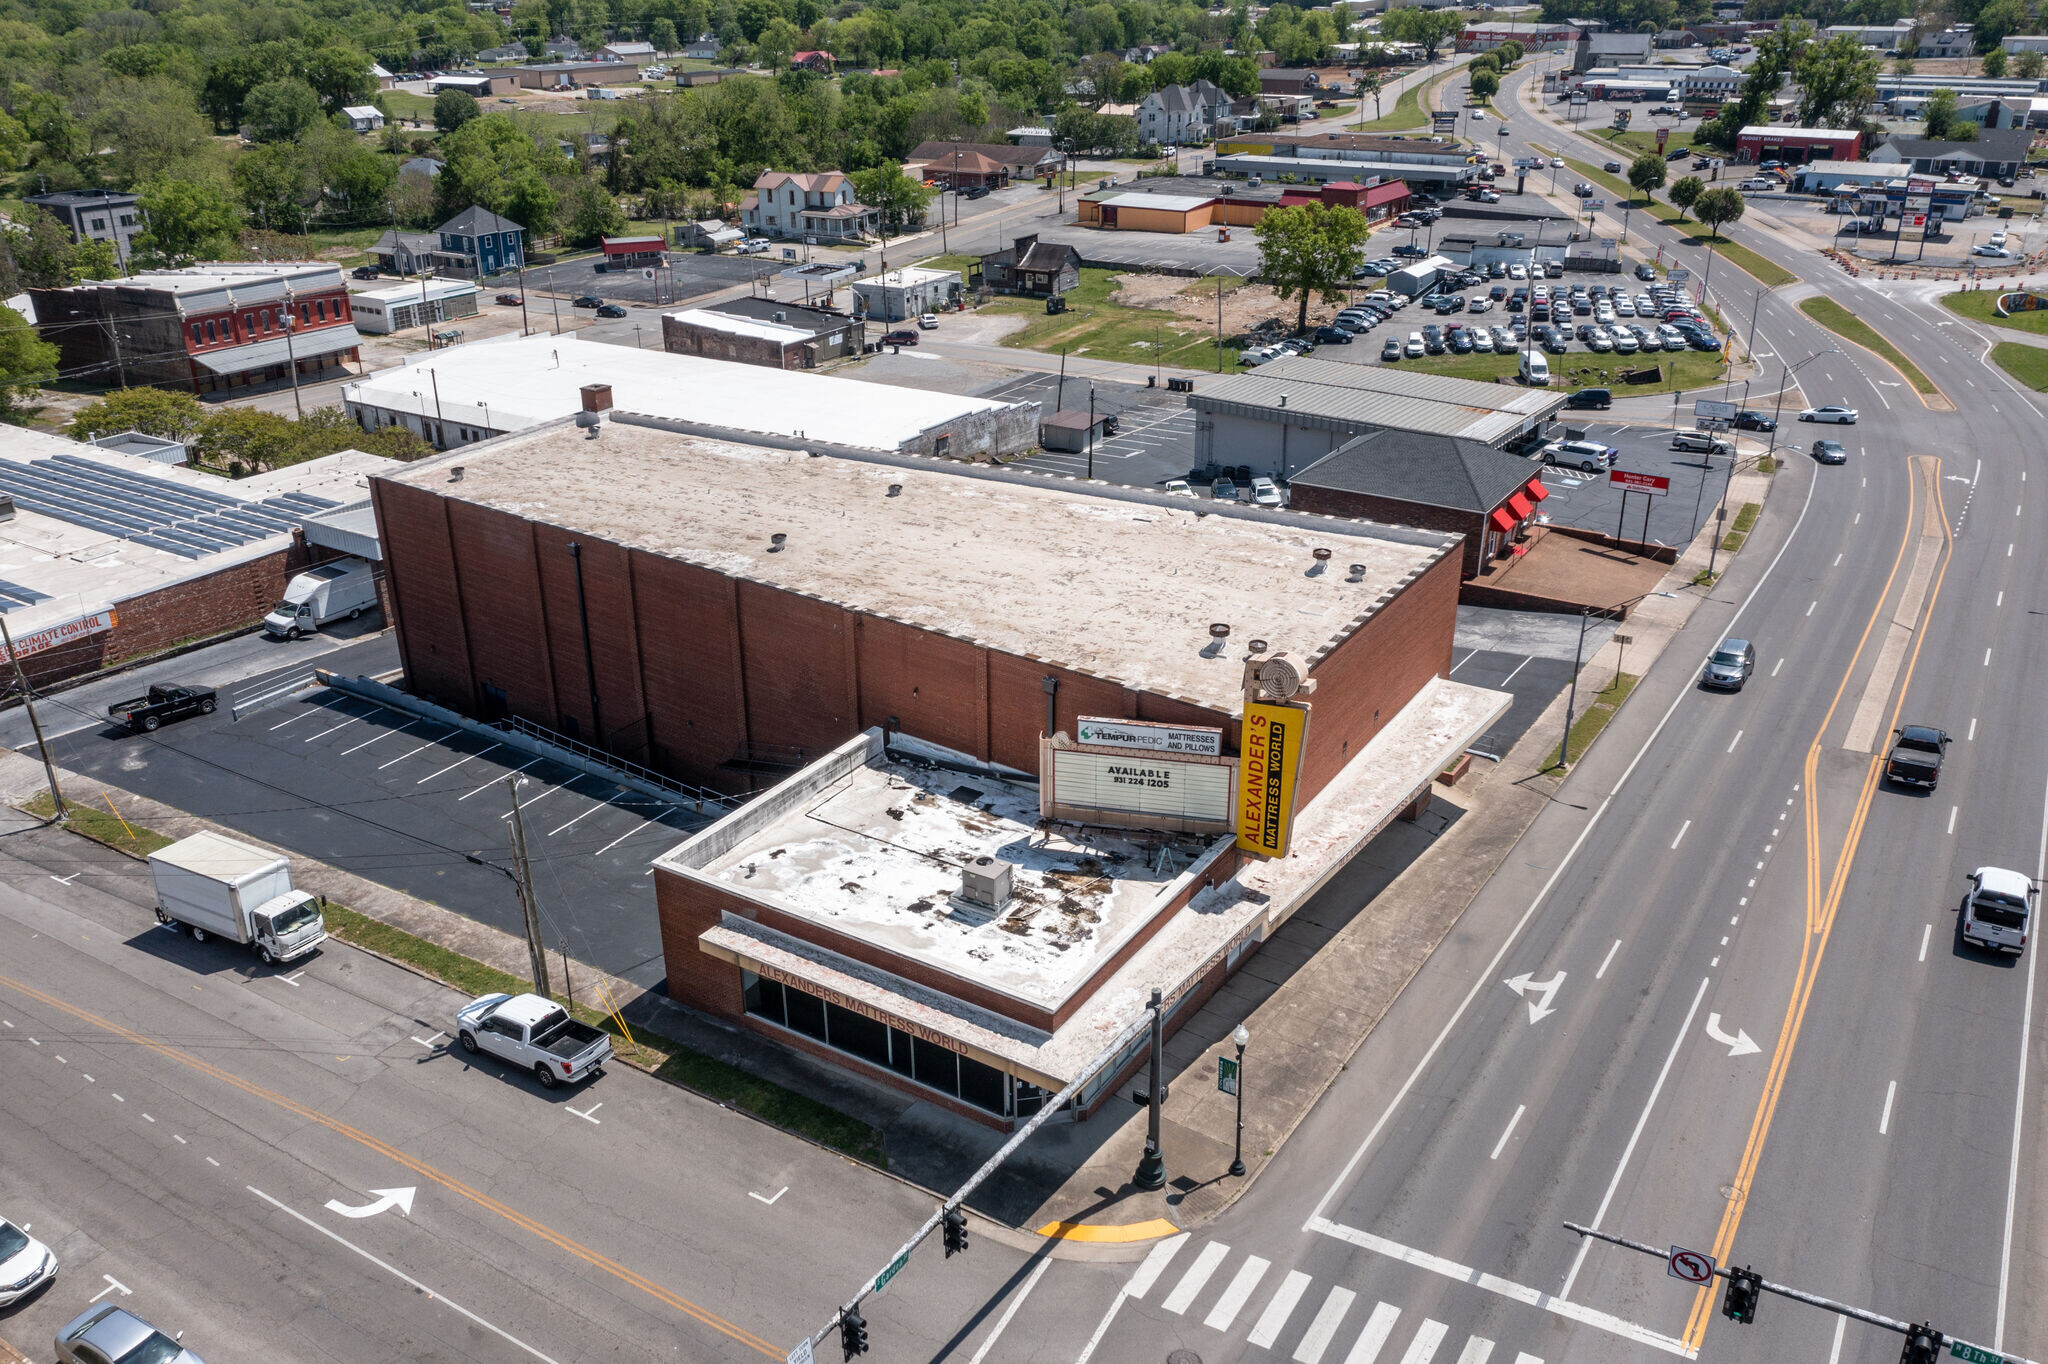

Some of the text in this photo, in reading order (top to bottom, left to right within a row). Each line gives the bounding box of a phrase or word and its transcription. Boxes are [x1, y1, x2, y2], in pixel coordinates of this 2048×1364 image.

[19, 629, 59, 649] CLIMATE
[60, 616, 102, 636] CONTROL
[1167, 742, 1215, 753] AND PILLOWS
[1168, 732, 1215, 744] MATTRESSES
[1108, 766, 1170, 779] AVAILABLE
[1114, 776, 1169, 788] 931 224 1205
[1244, 714, 1267, 845] ALEXANDER'S
[1265, 724, 1283, 847] MATTRESS WORLD
[1179, 925, 1251, 993] MATTRESS WORLD
[759, 963, 968, 1055] ALEXANDERS MATTRESS WORLD
[881, 1259, 903, 1286] Garden
[1956, 1343, 1962, 1351] W
[1990, 1355, 1999, 1363] St
